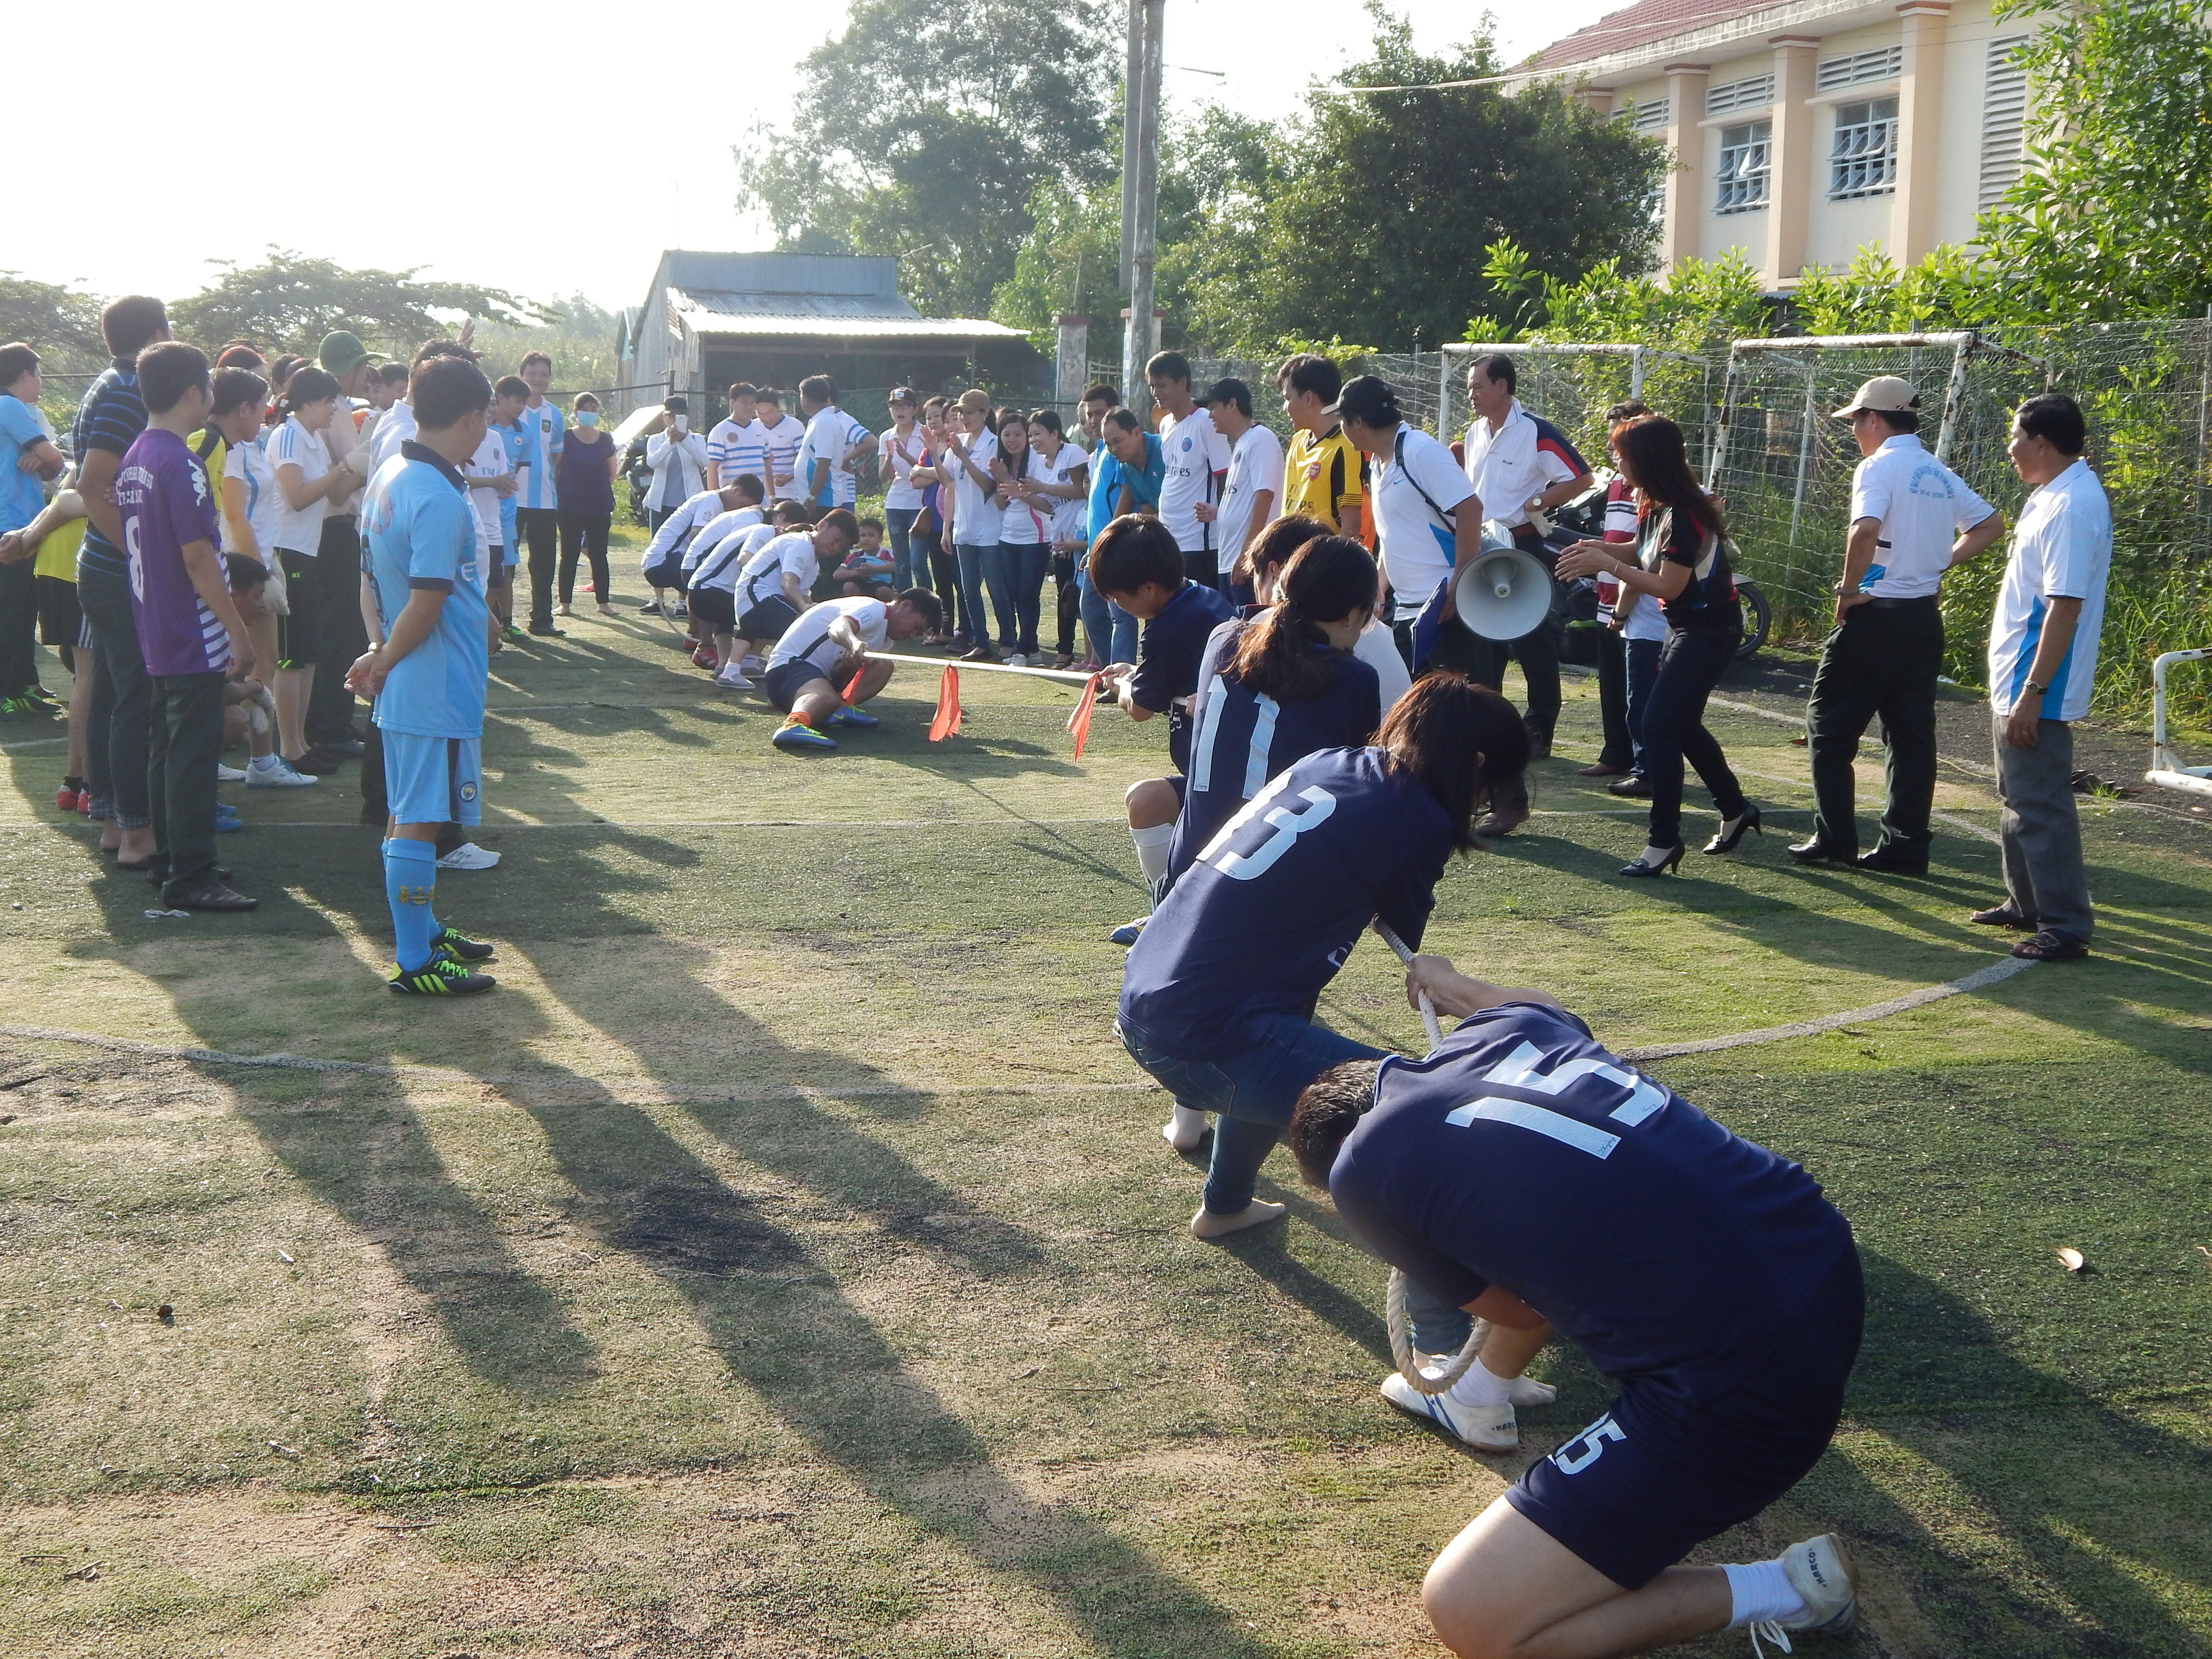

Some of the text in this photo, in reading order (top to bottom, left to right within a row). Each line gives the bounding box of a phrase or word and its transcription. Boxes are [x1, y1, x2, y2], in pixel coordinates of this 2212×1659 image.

[1193, 674, 1280, 800] 11
[1195, 772, 1337, 880] 13
[1444, 1040, 1665, 1160] 15
[1496, 1422, 1516, 1431] MARC
